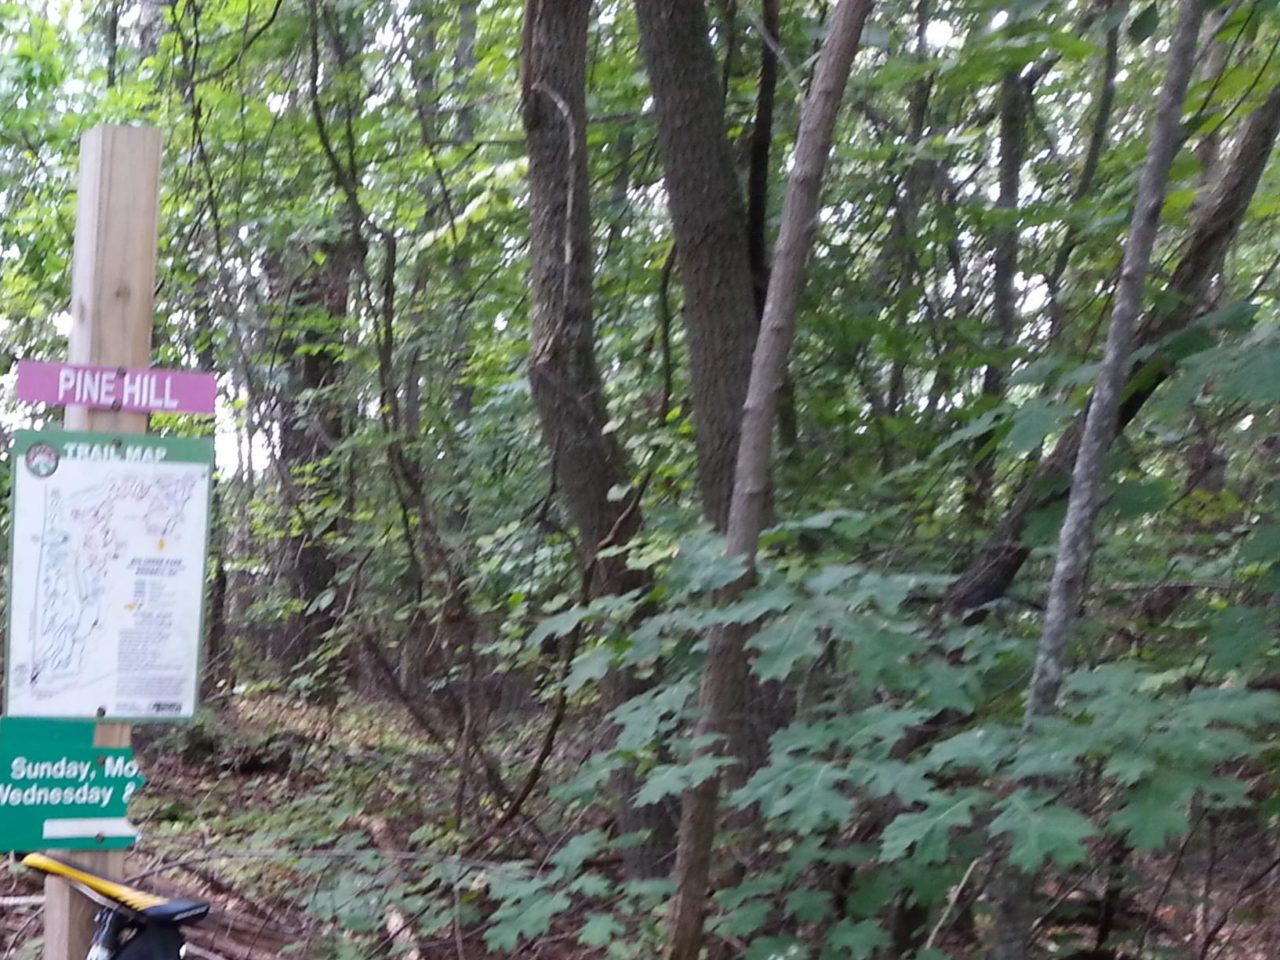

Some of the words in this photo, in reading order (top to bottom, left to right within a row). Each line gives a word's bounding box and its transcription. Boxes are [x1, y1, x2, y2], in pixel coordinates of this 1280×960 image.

[58, 367, 117, 404] PINE
[123, 372, 178, 409] HILL
[63, 442, 117, 461] TRAIL
[125, 446, 168, 463] MAP
[10, 756, 97, 782] Sunday,
[104, 755, 143, 779] Mo
